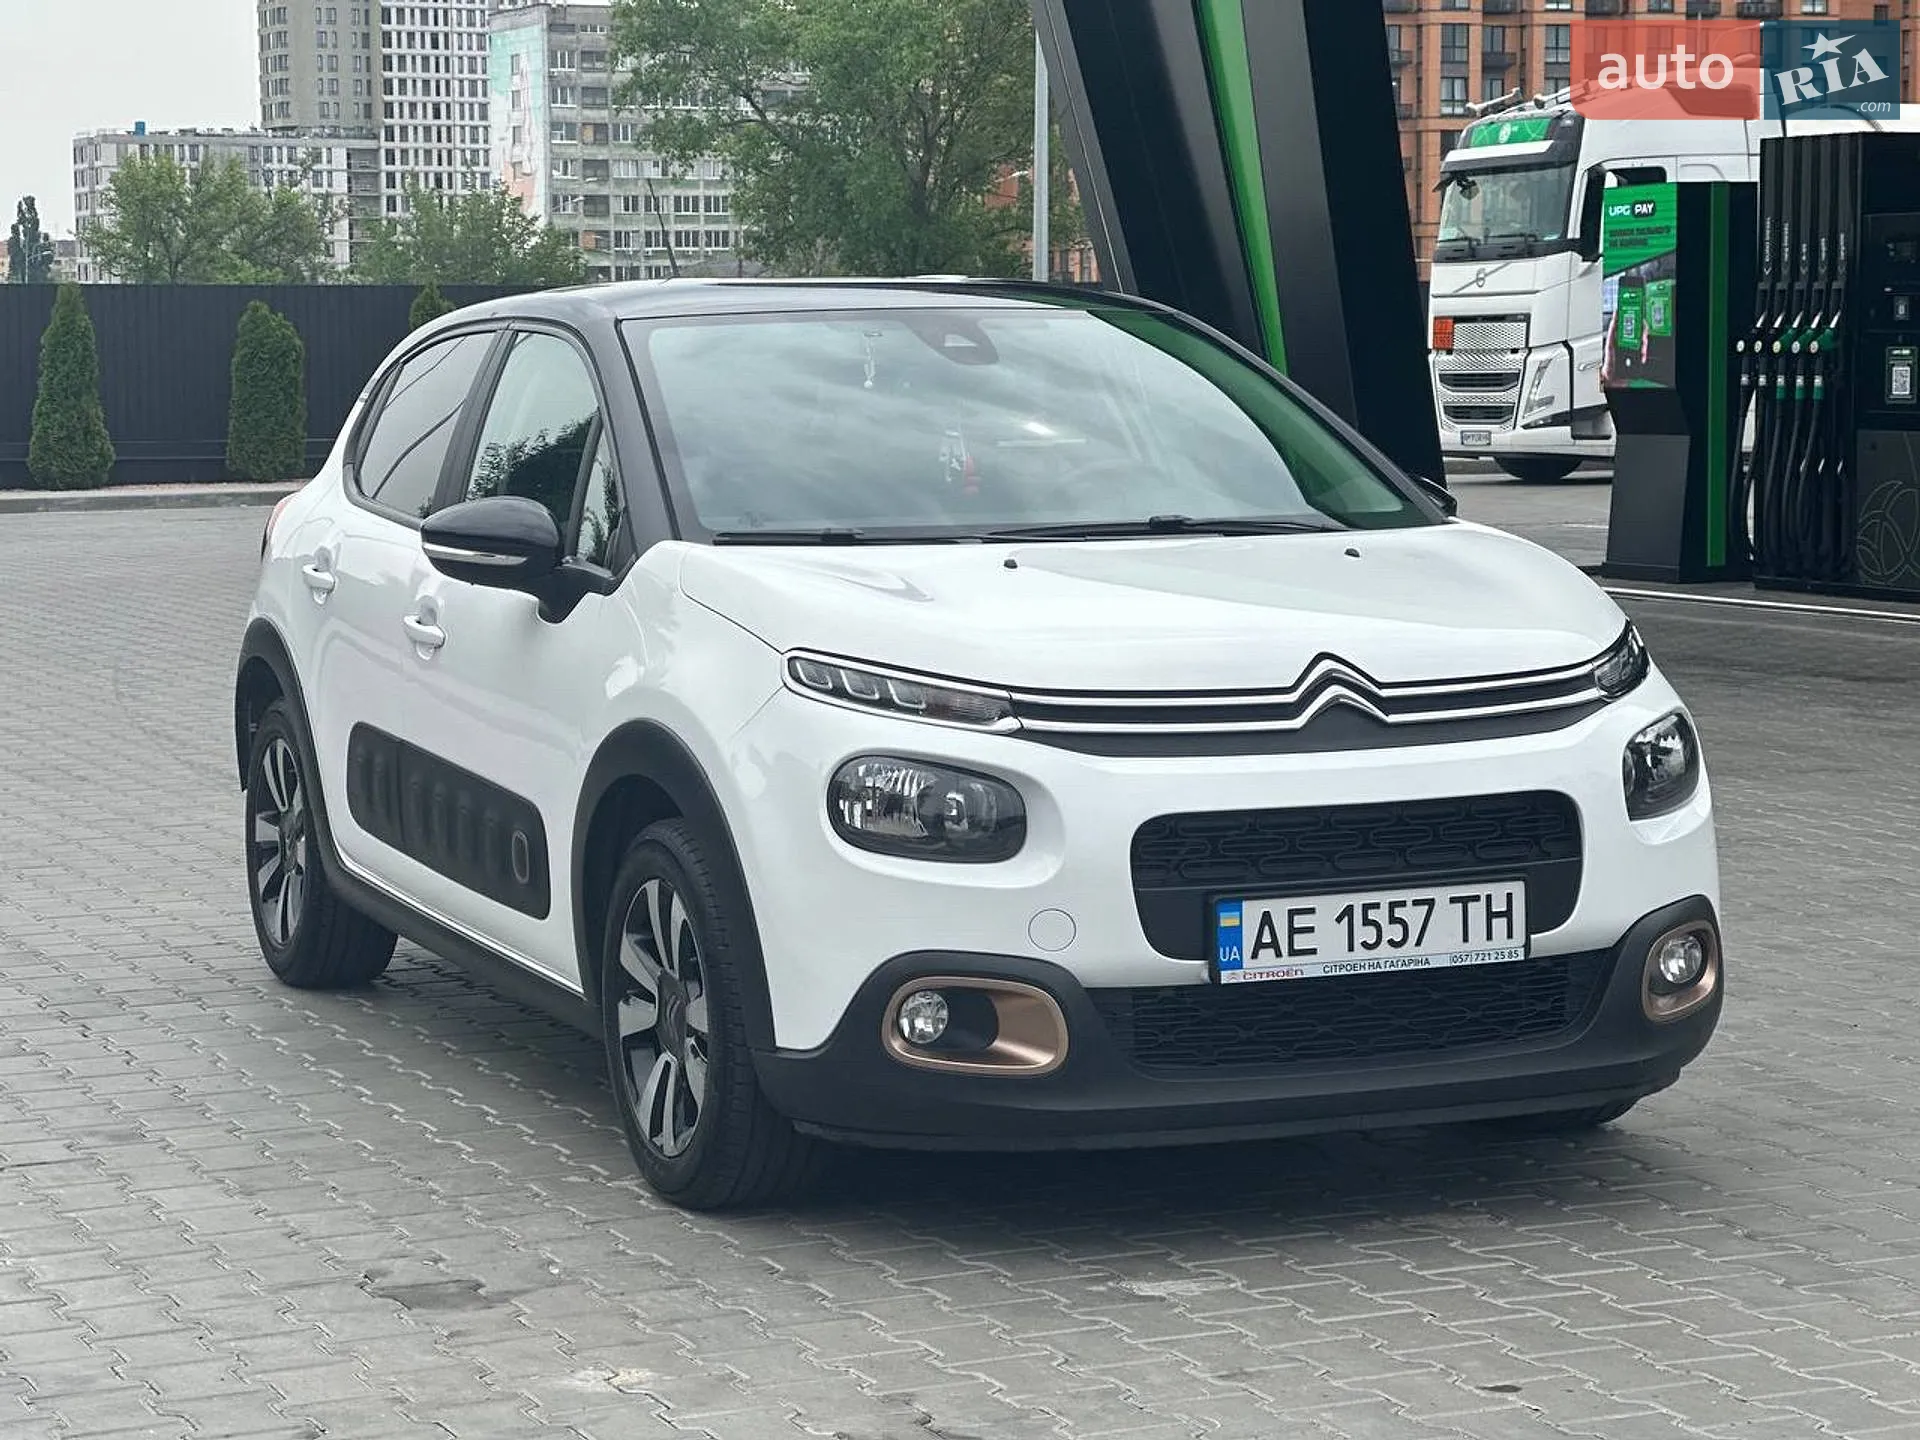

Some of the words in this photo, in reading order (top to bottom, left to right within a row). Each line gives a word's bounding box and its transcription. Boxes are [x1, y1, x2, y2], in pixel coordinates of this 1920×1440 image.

[1608, 205, 1631, 216] UPG
[1634, 202, 1655, 215] PAY
[1250, 907, 1318, 960] AE
[1334, 897, 1436, 952] 1557
[1448, 892, 1514, 944] TH
[1219, 945, 1241, 962] UA
[1474, 951, 1492, 962] 721
